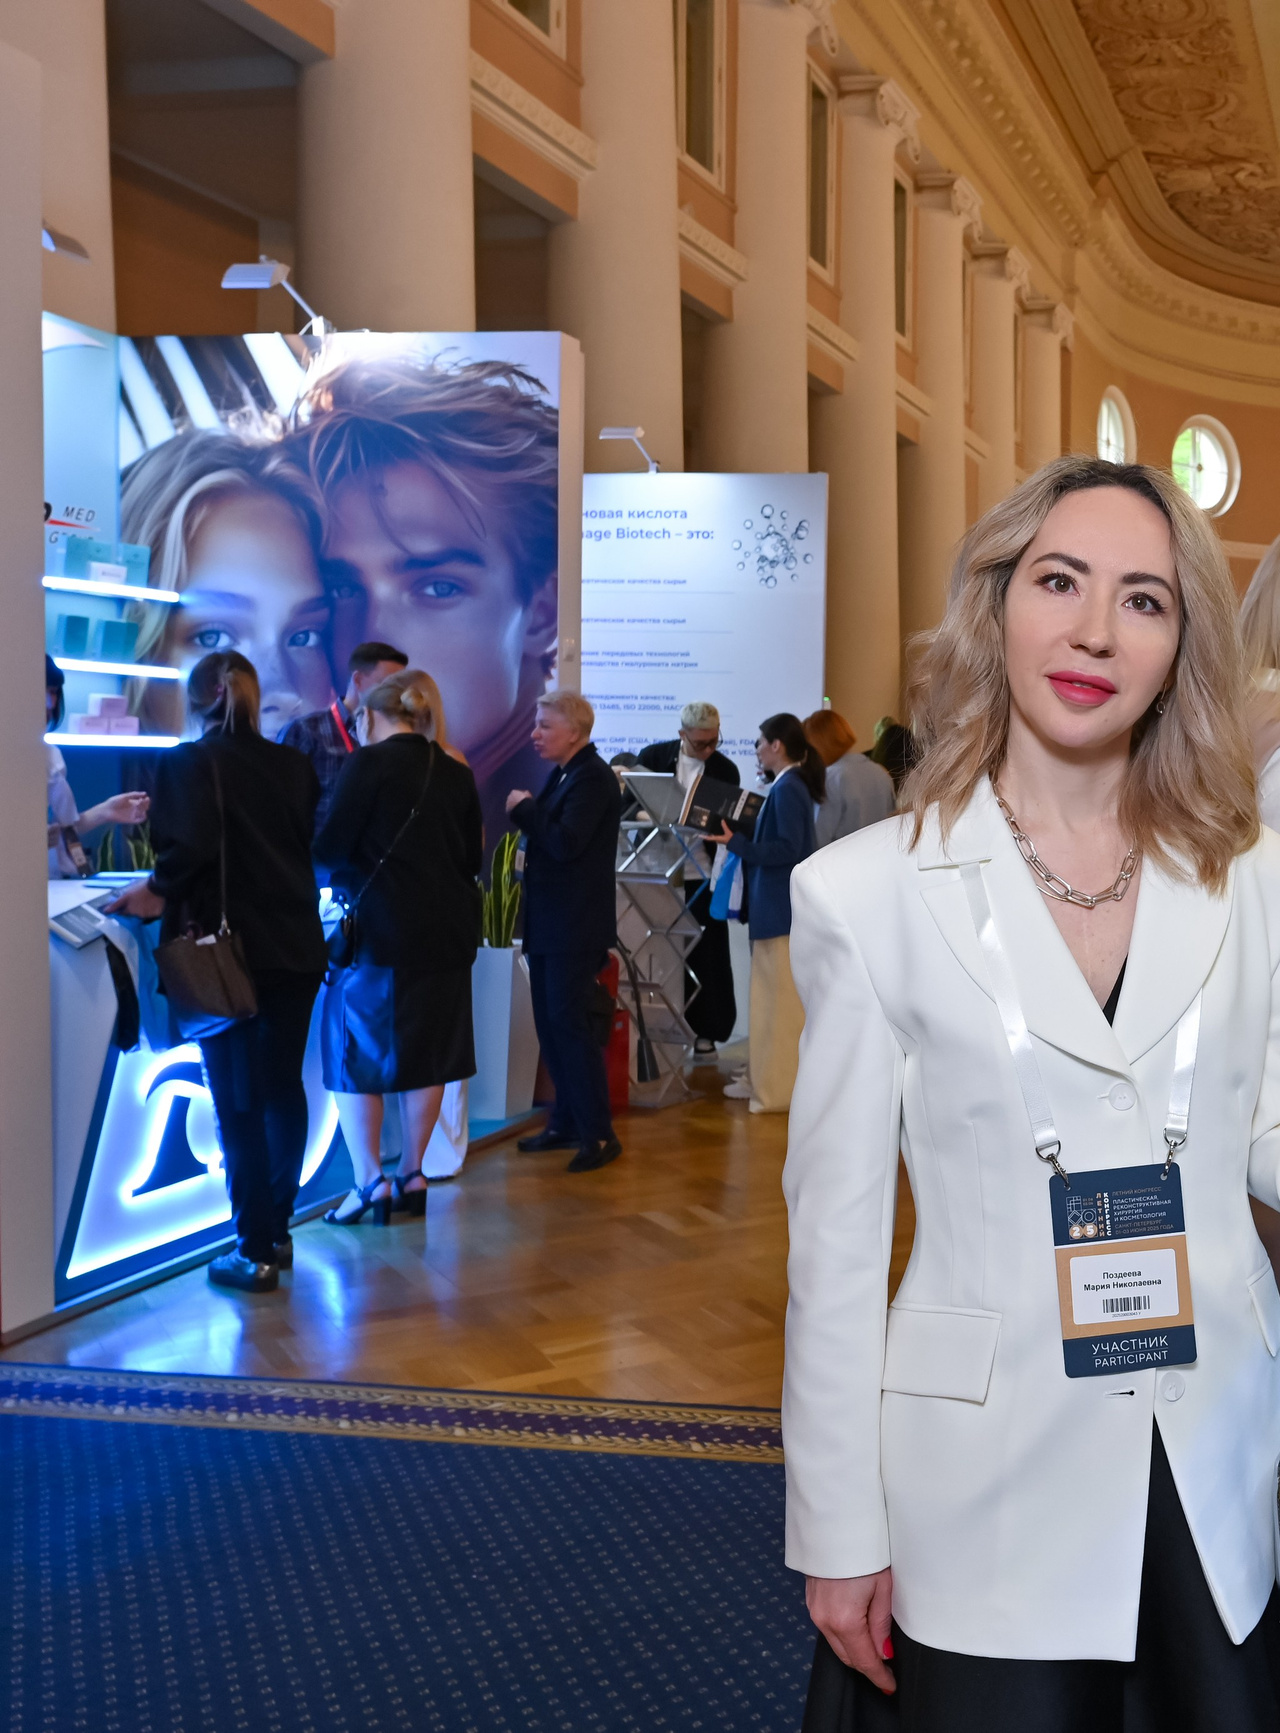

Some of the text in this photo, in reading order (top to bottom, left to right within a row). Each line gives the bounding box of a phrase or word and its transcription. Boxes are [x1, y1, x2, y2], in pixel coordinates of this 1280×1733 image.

[63, 506, 96, 522] MED
[628, 510, 688, 519] кислота
[581, 529, 612, 541] age
[616, 527, 671, 539] Biotech
[686, 530, 714, 539] это:
[1113, 1199, 1171, 1210] РЕКОНСТРУКТИВНАЯ
[1114, 1208, 1142, 1216] ХИРУРГИЯ
[1120, 1211, 1166, 1221] КОСМЕТОЛОГИЯ
[1103, 1270, 1142, 1279] Поздеева
[1084, 1279, 1161, 1291] Мария Николаевна
[1092, 1335, 1168, 1355] УЧАСТНИК
[1095, 1350, 1168, 1368] PARTICIPANT
